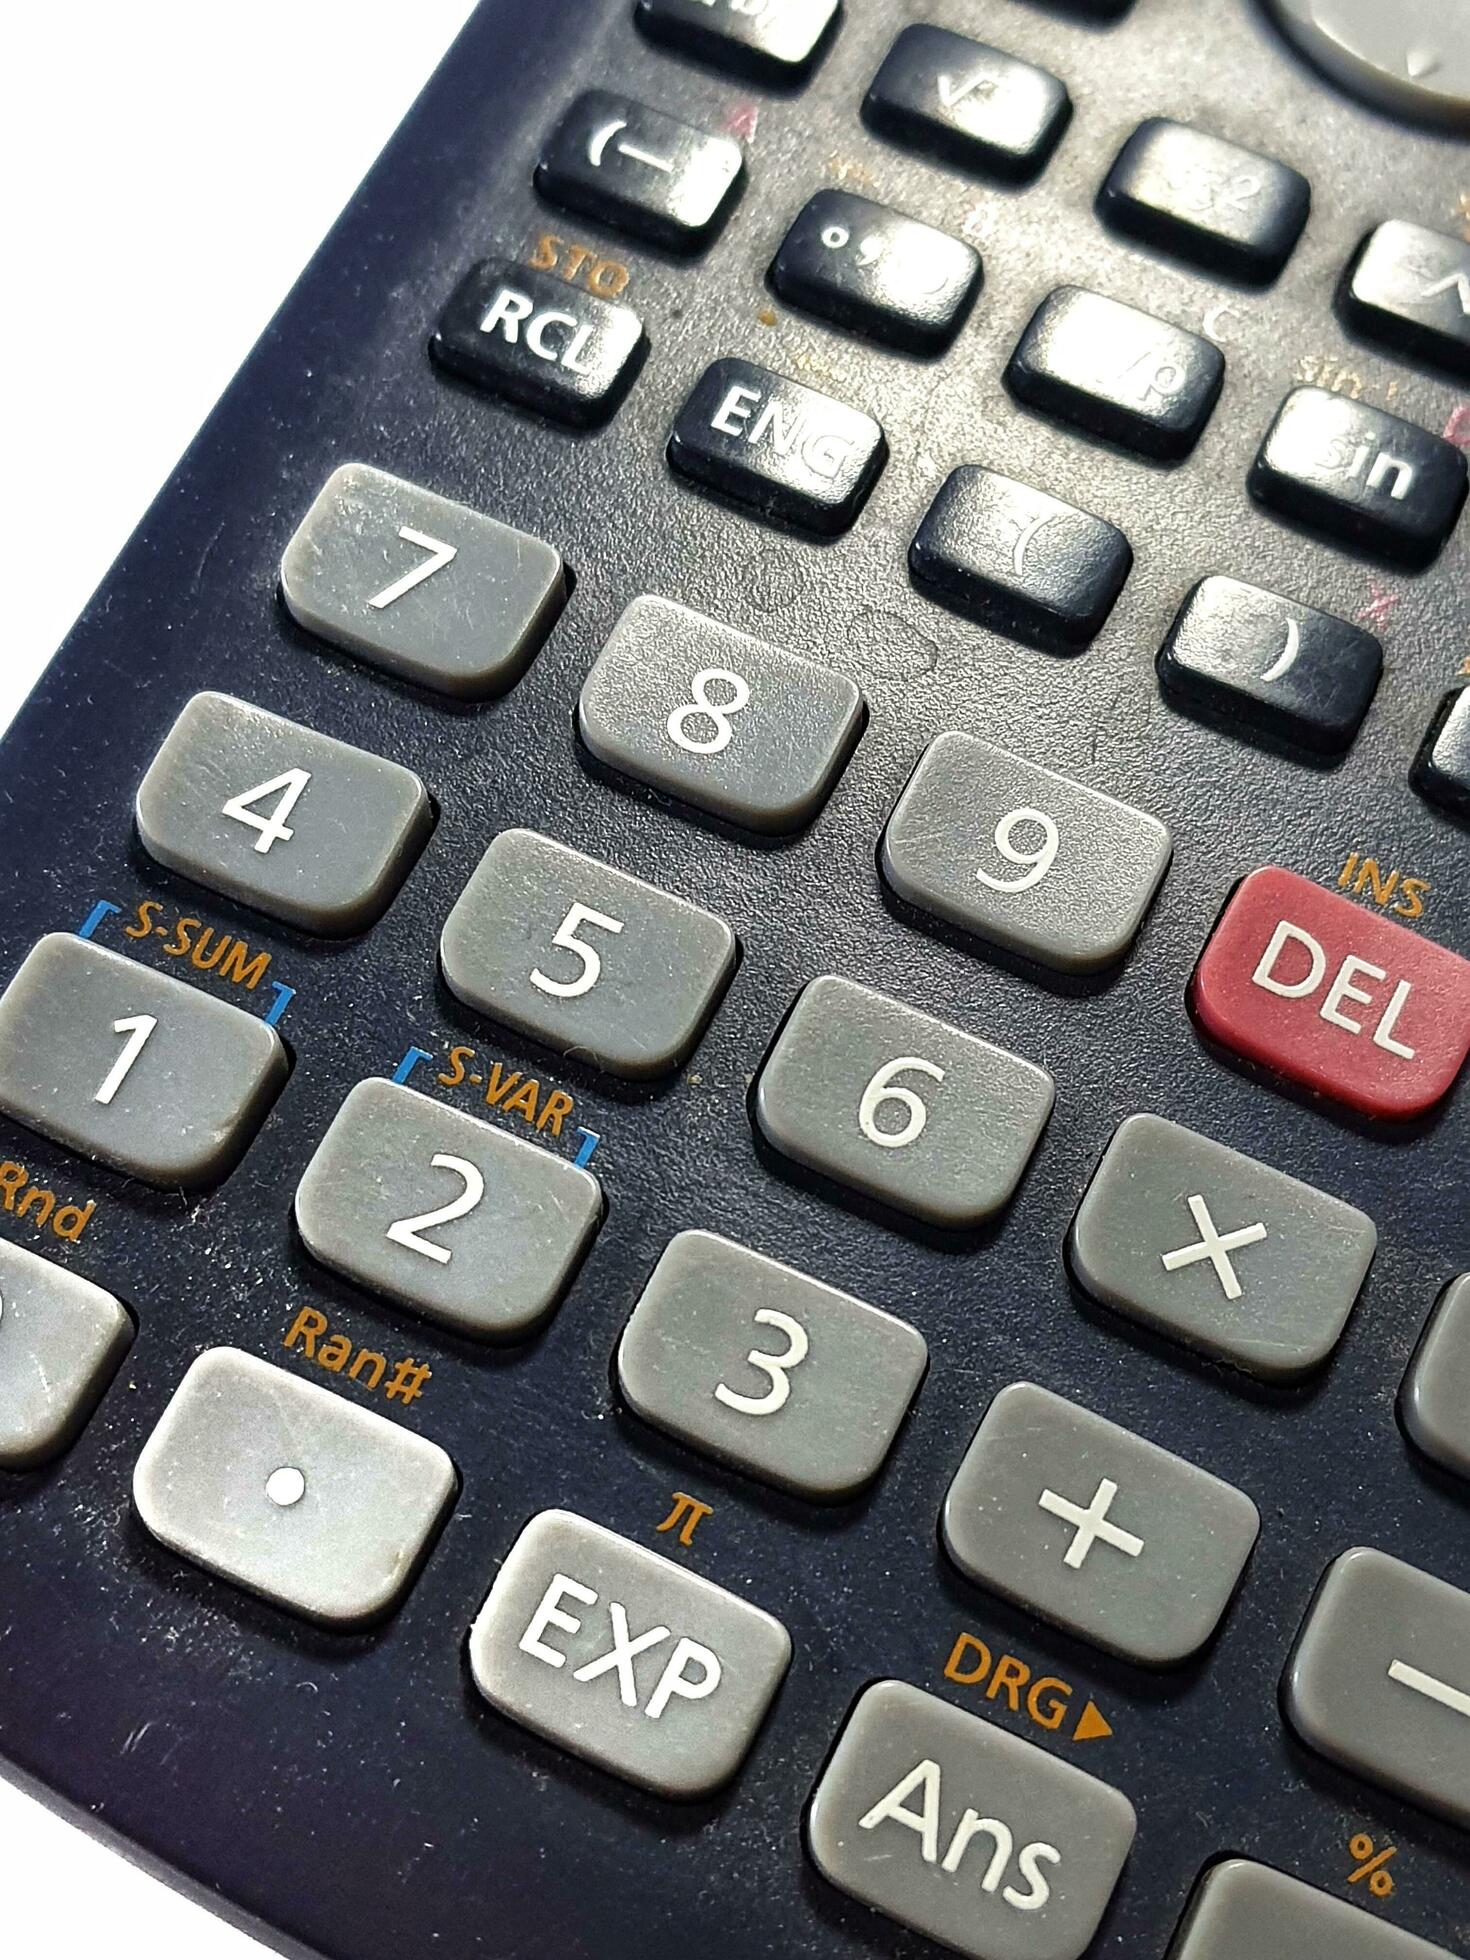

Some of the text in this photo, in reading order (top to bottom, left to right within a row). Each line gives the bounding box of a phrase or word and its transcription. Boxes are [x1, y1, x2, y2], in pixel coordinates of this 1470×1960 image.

[529, 233, 630, 299] STO
[479, 288, 598, 377] RCL
[709, 385, 858, 481] ENG
[1313, 431, 1414, 500] sin
[367, 526, 457, 609] 7
[666, 667, 751, 755] 8
[221, 767, 312, 854] 4
[975, 807, 1060, 894] 9
[1337, 851, 1432, 919] INS
[124, 900, 273, 991] S-SUM
[528, 901, 625, 998] 5
[1250, 918, 1417, 1061] DEL
[94, 1012, 159, 1105] 1
[437, 1046, 575, 1137] S-VAR
[857, 1056, 945, 1148] 6
[385, 1152, 486, 1265] 2
[280, 1305, 434, 1405] Ran#
[714, 1307, 809, 1416] 3
[517, 1571, 723, 1720] EXP
[942, 1631, 1075, 1731] DRG
[858, 1757, 1062, 1912] Ans
[1346, 1831, 1397, 1898] %
